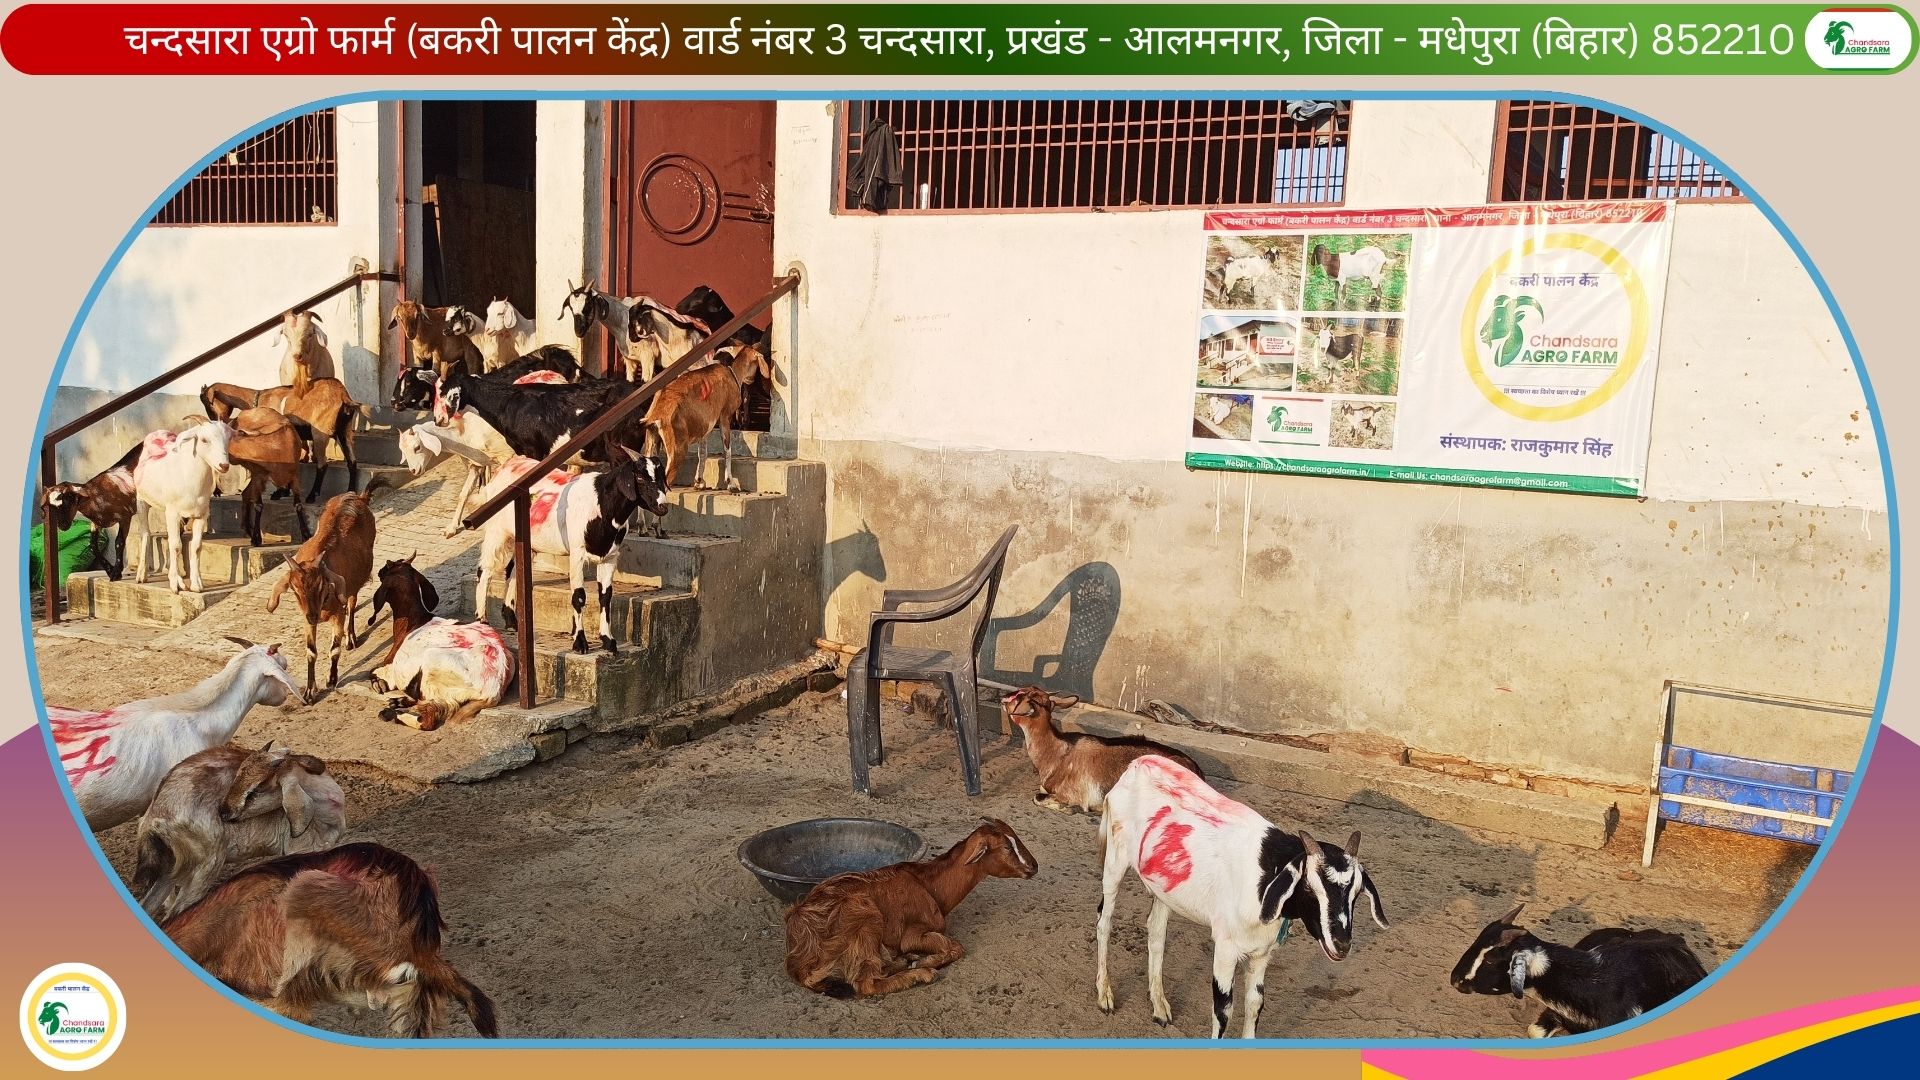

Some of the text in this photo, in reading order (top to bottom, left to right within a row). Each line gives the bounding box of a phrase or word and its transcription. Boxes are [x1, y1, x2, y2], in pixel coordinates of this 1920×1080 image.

[1543, 275, 1576, 287] पालन
[1578, 272, 1600, 287] केंद्र
[1529, 334, 1619, 348] Chandsara
[1520, 349, 1619, 364] AGRO FARM
[1439, 432, 1614, 459] संस्थापक: राजकुमार सिंह
[1389, 469, 1415, 480] E-mail
[1429, 472, 1570, 489] chandsaraagrofarm@gmail.com
